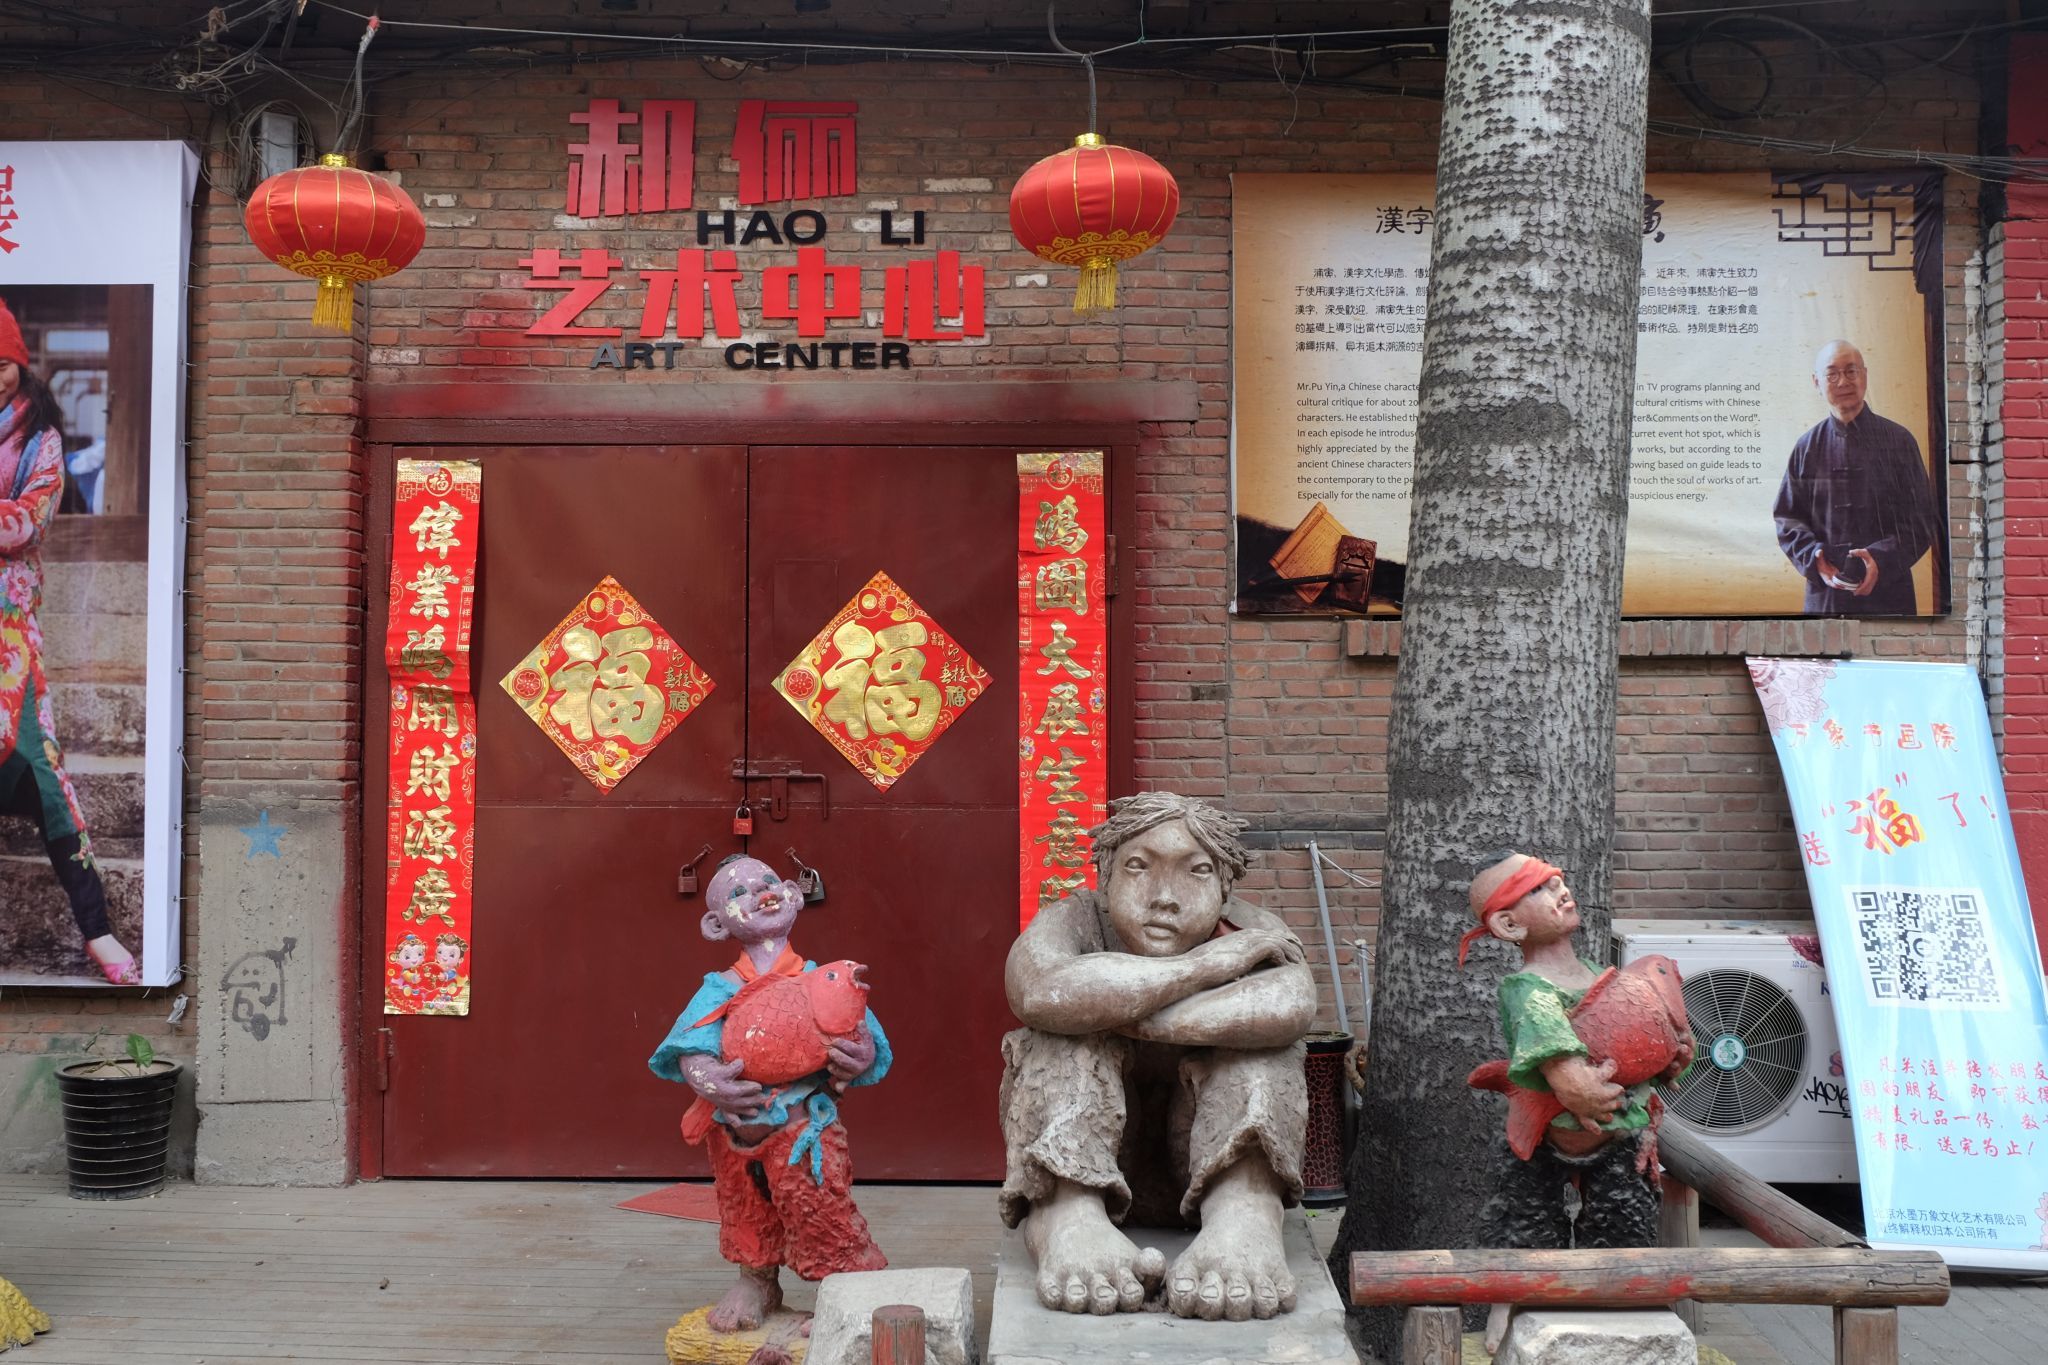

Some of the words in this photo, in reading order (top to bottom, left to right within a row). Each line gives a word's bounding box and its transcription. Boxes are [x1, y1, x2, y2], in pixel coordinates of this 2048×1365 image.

[1376, 206, 1434, 235] 漢字
[697, 210, 827, 245] HAO
[880, 210, 925, 245] LI
[518, 247, 985, 341] 艺术中心
[590, 342, 684, 369] ART
[725, 342, 911, 370] CENTER
[1325, 383, 1346, 392] Yin,a
[1636, 383, 1644, 391] in
[1647, 383, 1657, 391] TV
[1661, 384, 1701, 393] programs
[1705, 383, 1741, 393] planning
[1745, 383, 1760, 391] and
[1297, 398, 1328, 406] cultural
[1332, 398, 1363, 408] critique
[1366, 398, 1378, 406] for
[1381, 398, 1405, 406] about
[1714, 414, 1728, 422] the
[1308, 429, 1327, 437] each
[1330, 429, 1363, 438] episode
[1366, 429, 1376, 437] he
[1703, 431, 1724, 439] spot,
[1298, 445, 1322, 454] highly
[1326, 445, 1377, 454] appreciated
[1381, 445, 1391, 454] by
[1637, 445, 1666, 454] works,
[1670, 445, 1684, 453] but
[1689, 445, 1730, 455] according
[1747, 445, 1760, 453] the
[1297, 460, 1328, 468] ancient
[1332, 460, 1364, 468] Chinese
[1368, 460, 1412, 468] characters
[1658, 461, 1684, 469] based
[1701, 461, 1724, 471] guide
[1727, 461, 1749, 469] leads
[1298, 476, 1311, 484] the
[1314, 476, 1374, 485] contemporary
[1388, 476, 1401, 484] the
[1634, 476, 1658, 484] touch
[1661, 476, 1674, 484] the
[1677, 476, 1694, 484] soul
[1696, 476, 1705, 484] of
[1708, 476, 1733, 484] works
[1736, 476, 1744, 484] of
[1298, 491, 1338, 501] Especially
[1341, 491, 1353, 499] for
[1398, 491, 1406, 499] of
[1630, 492, 1673, 501] auspicious
[1676, 493, 1708, 502] energy.
[549, 623, 665, 744] 福
[823, 621, 943, 742] 福
